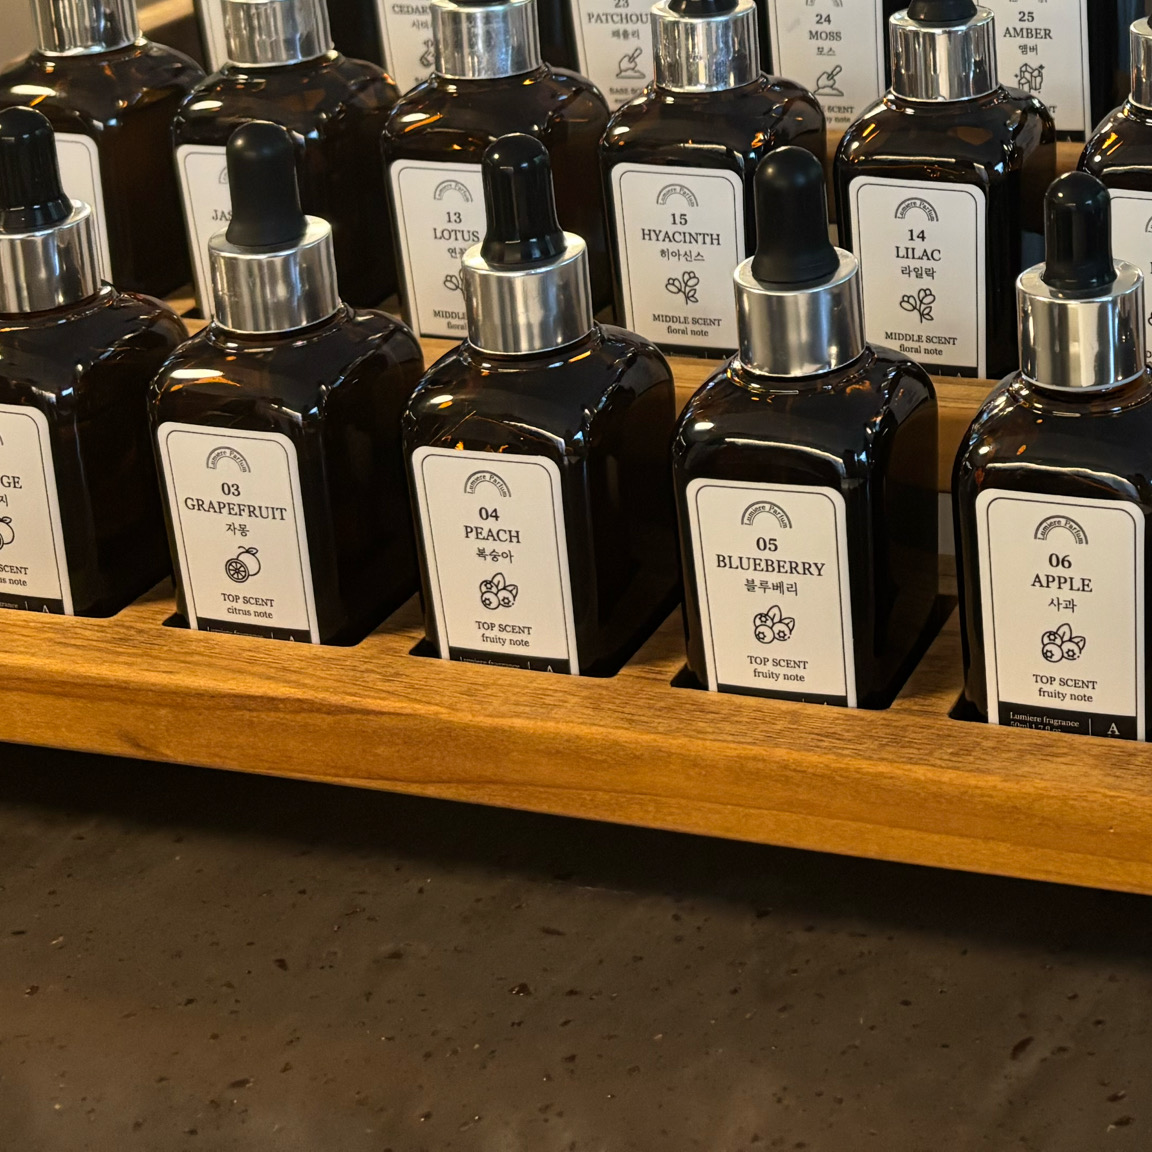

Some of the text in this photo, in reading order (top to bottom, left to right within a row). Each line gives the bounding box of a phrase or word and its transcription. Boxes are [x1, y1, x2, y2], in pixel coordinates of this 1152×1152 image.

[815, 13, 832, 25] 24
[1018, 11, 1035, 23] 25
[808, 30, 842, 41] MOSS
[1003, 26, 1053, 40] AMBER
[816, 46, 837, 56] 모스
[446, 211, 463, 224] 13
[671, 213, 688, 226] 15
[433, 227, 480, 243] LOTUS
[641, 228, 722, 246] HYACINTH
[907, 229, 926, 242] 14
[660, 248, 705, 262] 히아신스
[895, 246, 942, 261] LILAC
[901, 265, 937, 280] 라일락
[652, 313, 722, 327] MIDDLE SCENT
[667, 326, 709, 337] floral note
[884, 331, 958, 346] MIDDLE SCENT
[899, 344, 943, 356] floral note
[221, 482, 241, 496] 03
[467, 474, 508, 498] Lumiere Parfum
[184, 496, 287, 520] GRAPEFRUIT
[478, 506, 501, 521] 04
[744, 504, 788, 529] Lumiere Parfum
[226, 522, 250, 537] 자몽
[463, 525, 521, 544] PEACH
[1037, 519, 1084, 545] Lumiere Parfum
[756, 536, 778, 552] 05
[476, 547, 514, 564] 복숭아
[1048, 553, 1072, 569] 06
[715, 553, 826, 577] BLUEBERRY
[9, 578, 28, 587] note
[744, 578, 798, 597] 블루베리
[1030, 573, 1093, 593] APPLE
[221, 592, 275, 607] TOP SCENT
[1048, 596, 1077, 613] 사과
[227, 605, 273, 619] citrus note
[475, 621, 532, 635] TOP SCENT
[481, 633, 530, 647] fruity note
[747, 655, 808, 670] TOP SCENT
[753, 668, 806, 682] fruity note
[1032, 673, 1098, 690] TOP SCENT
[1038, 687, 1094, 703] fruity note
[1010, 711, 1080, 728] Lumiere fragrance
[1107, 722, 1120, 735] A
